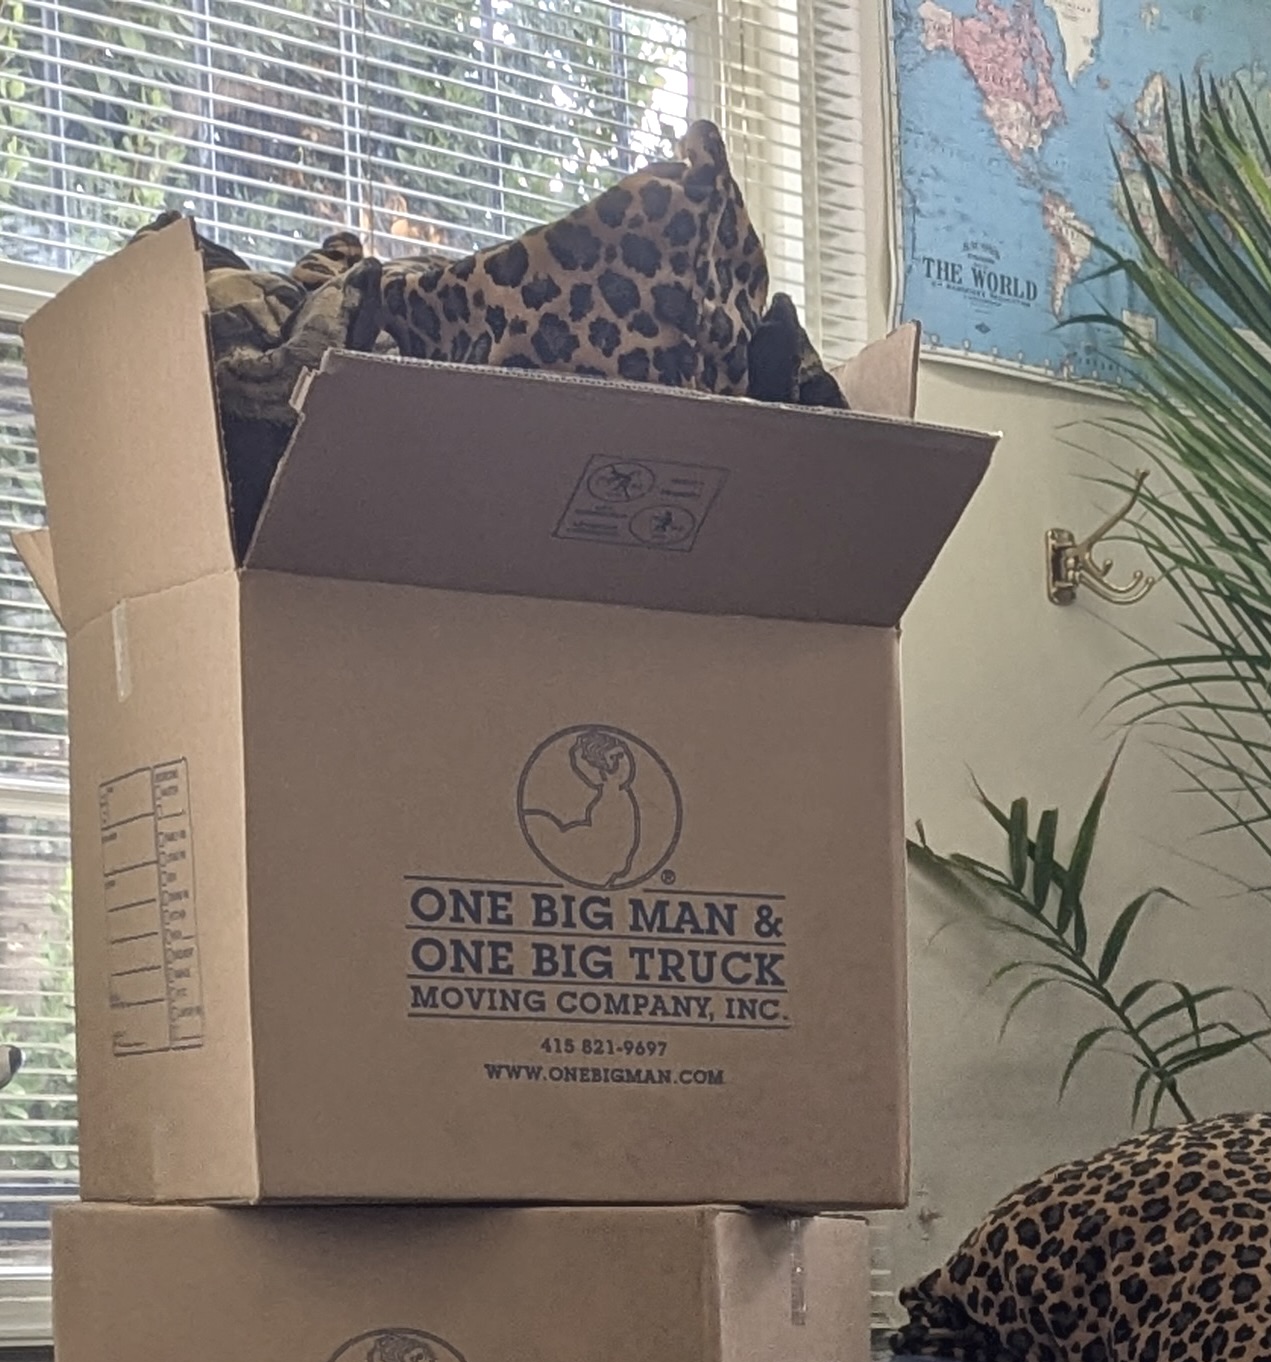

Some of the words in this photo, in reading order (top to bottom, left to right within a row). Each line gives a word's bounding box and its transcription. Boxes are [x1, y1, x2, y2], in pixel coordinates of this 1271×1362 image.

[922, 256, 962, 284] THE
[971, 267, 1038, 301] WORLD
[411, 887, 513, 926] ONE
[532, 893, 614, 931] BIG
[629, 899, 737, 937] MAN
[755, 905, 783, 938] &
[411, 938, 513, 975] ONE
[532, 942, 613, 979] BIG
[629, 947, 785, 986] TRUCK
[410, 985, 546, 1012] MOVING
[556, 991, 715, 1022] COMPANY,
[726, 998, 788, 1021] INC.
[541, 1038, 574, 1054] 415
[582, 1039, 667, 1056] 821-9697
[484, 1063, 724, 1085] WWW.ONEBIGMAN.COM
